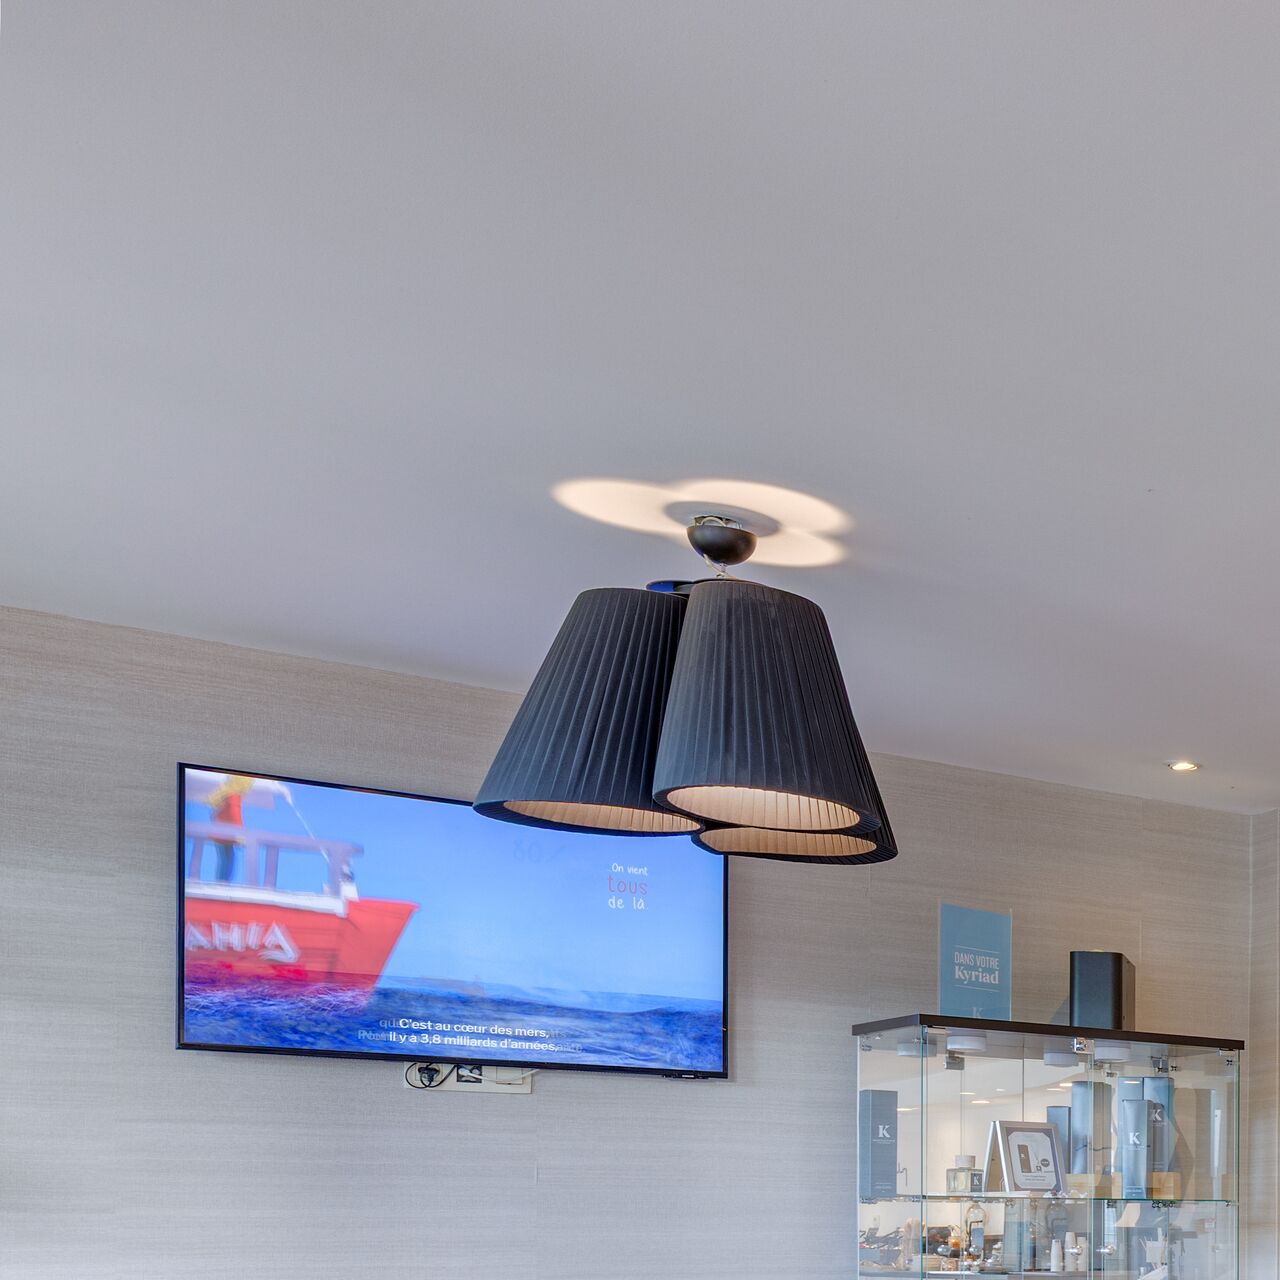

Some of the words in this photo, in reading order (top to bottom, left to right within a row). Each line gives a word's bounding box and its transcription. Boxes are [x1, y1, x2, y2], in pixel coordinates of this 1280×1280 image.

[608, 875, 648, 896] tous
[608, 896, 624, 909] de
[954, 951, 974, 966] DANS
[976, 955, 999, 970] VOTRE
[955, 965, 999, 984] Kyriad
[400, 1018, 432, 1030] C'est
[435, 1023, 452, 1032] au
[490, 1025, 512, 1036] des
[515, 1028, 549, 1039] mers,
[399, 1034, 407, 1044] y
[410, 1034, 417, 1043] a
[420, 1033, 441, 1045] 3,8
[444, 1036, 497, 1048] milliards
[500, 1037, 558, 1051] d'années,
[878, 1125, 890, 1138] K
[1129, 1132, 1140, 1145] K
[973, 1176, 980, 1185] K
